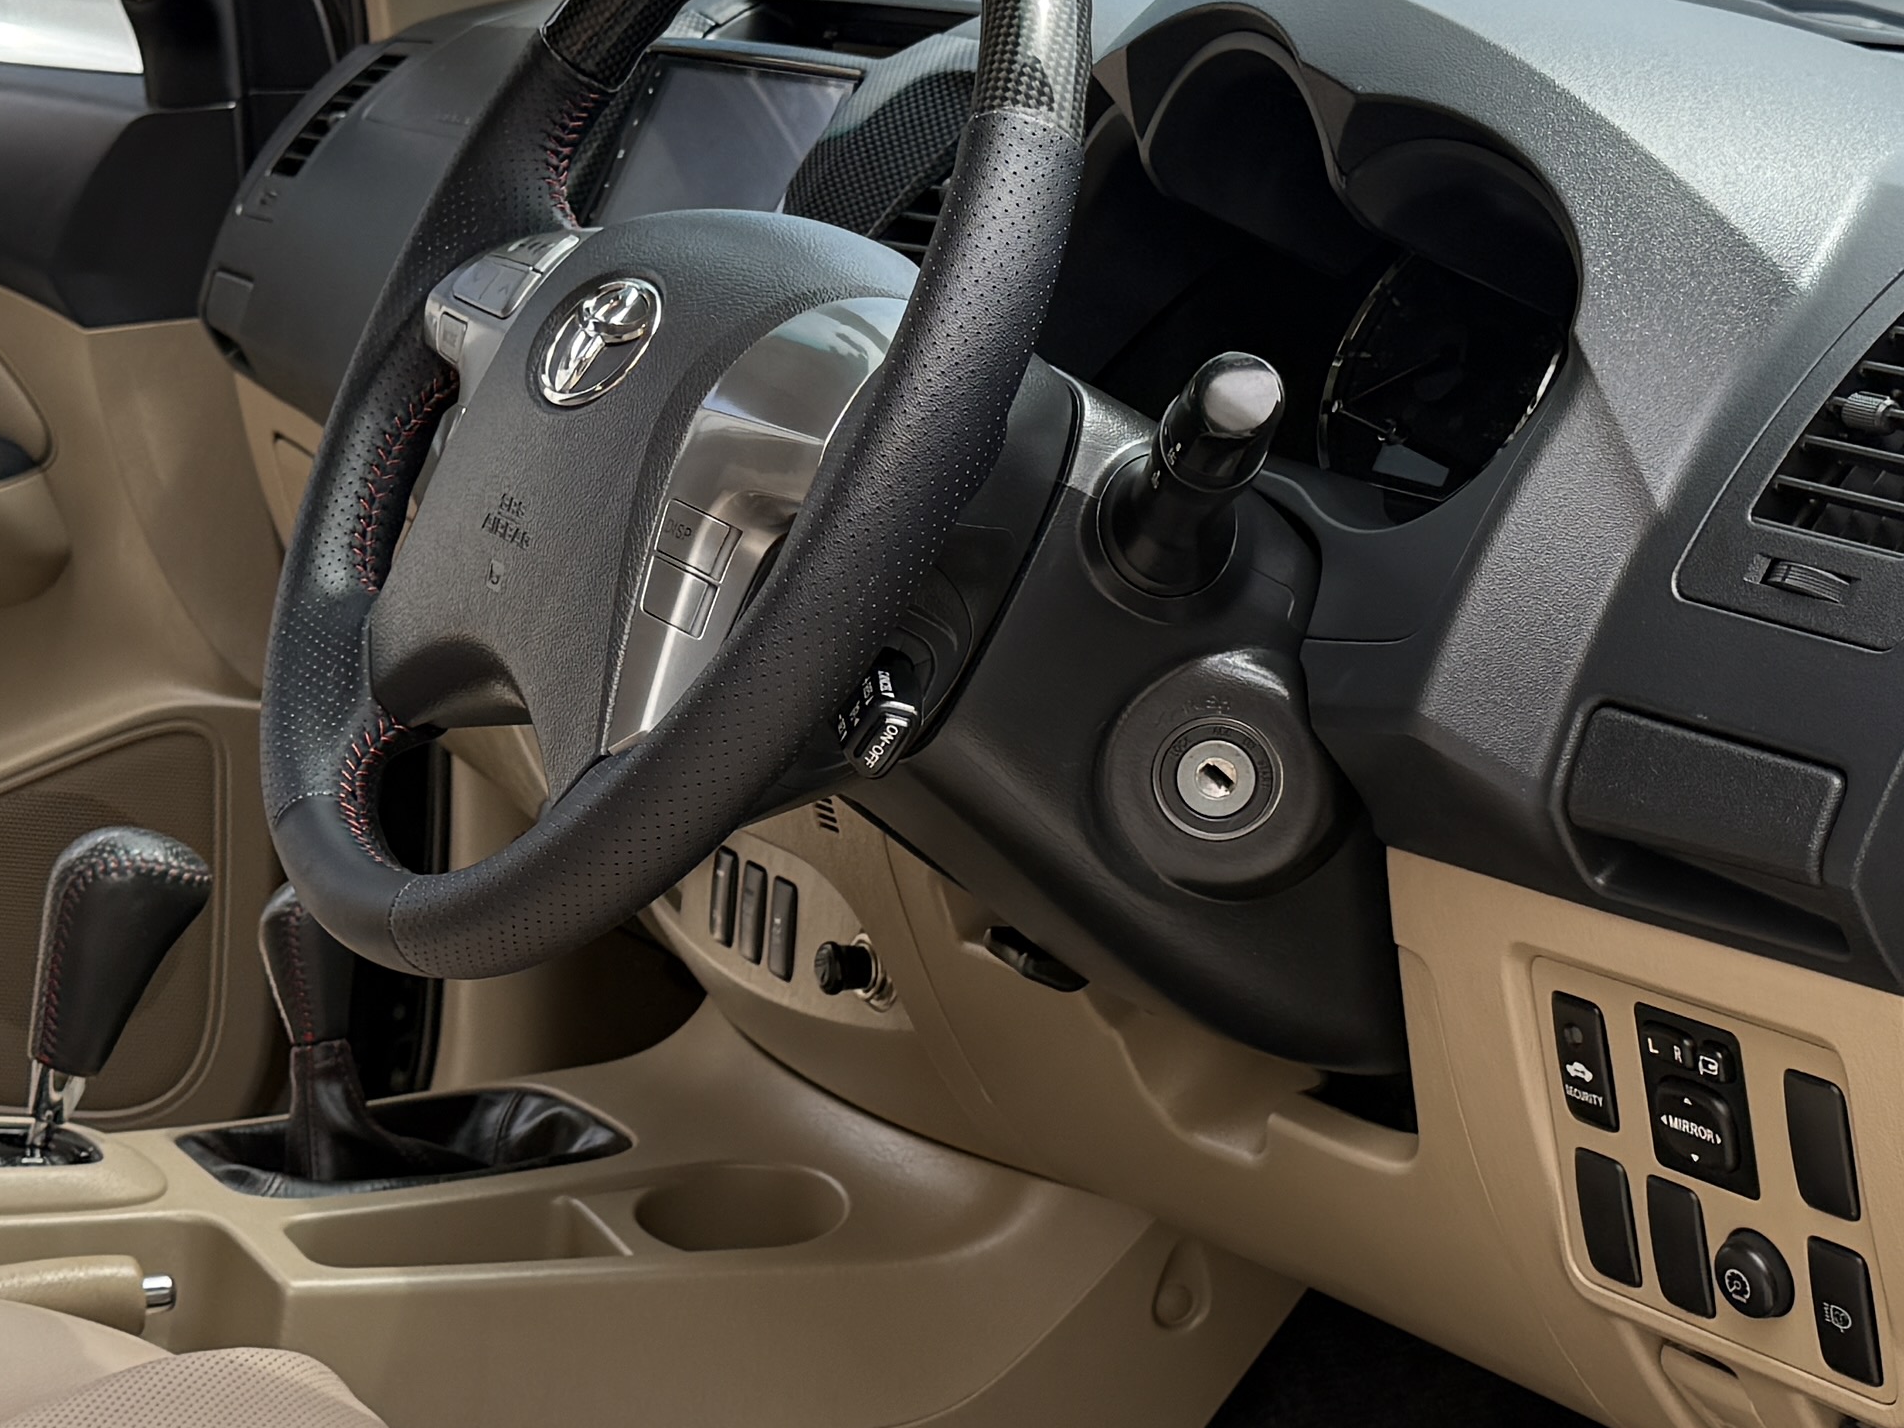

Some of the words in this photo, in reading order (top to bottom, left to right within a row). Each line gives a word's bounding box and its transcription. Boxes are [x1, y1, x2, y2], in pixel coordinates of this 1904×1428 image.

[663, 518, 692, 540] DISP
[863, 724, 900, 769] ON-OFF
[1647, 1036, 1660, 1054] L
[1673, 1044, 1683, 1064] R
[1564, 1083, 1604, 1108] SECURITY
[1668, 1114, 1716, 1145] MIRROR
